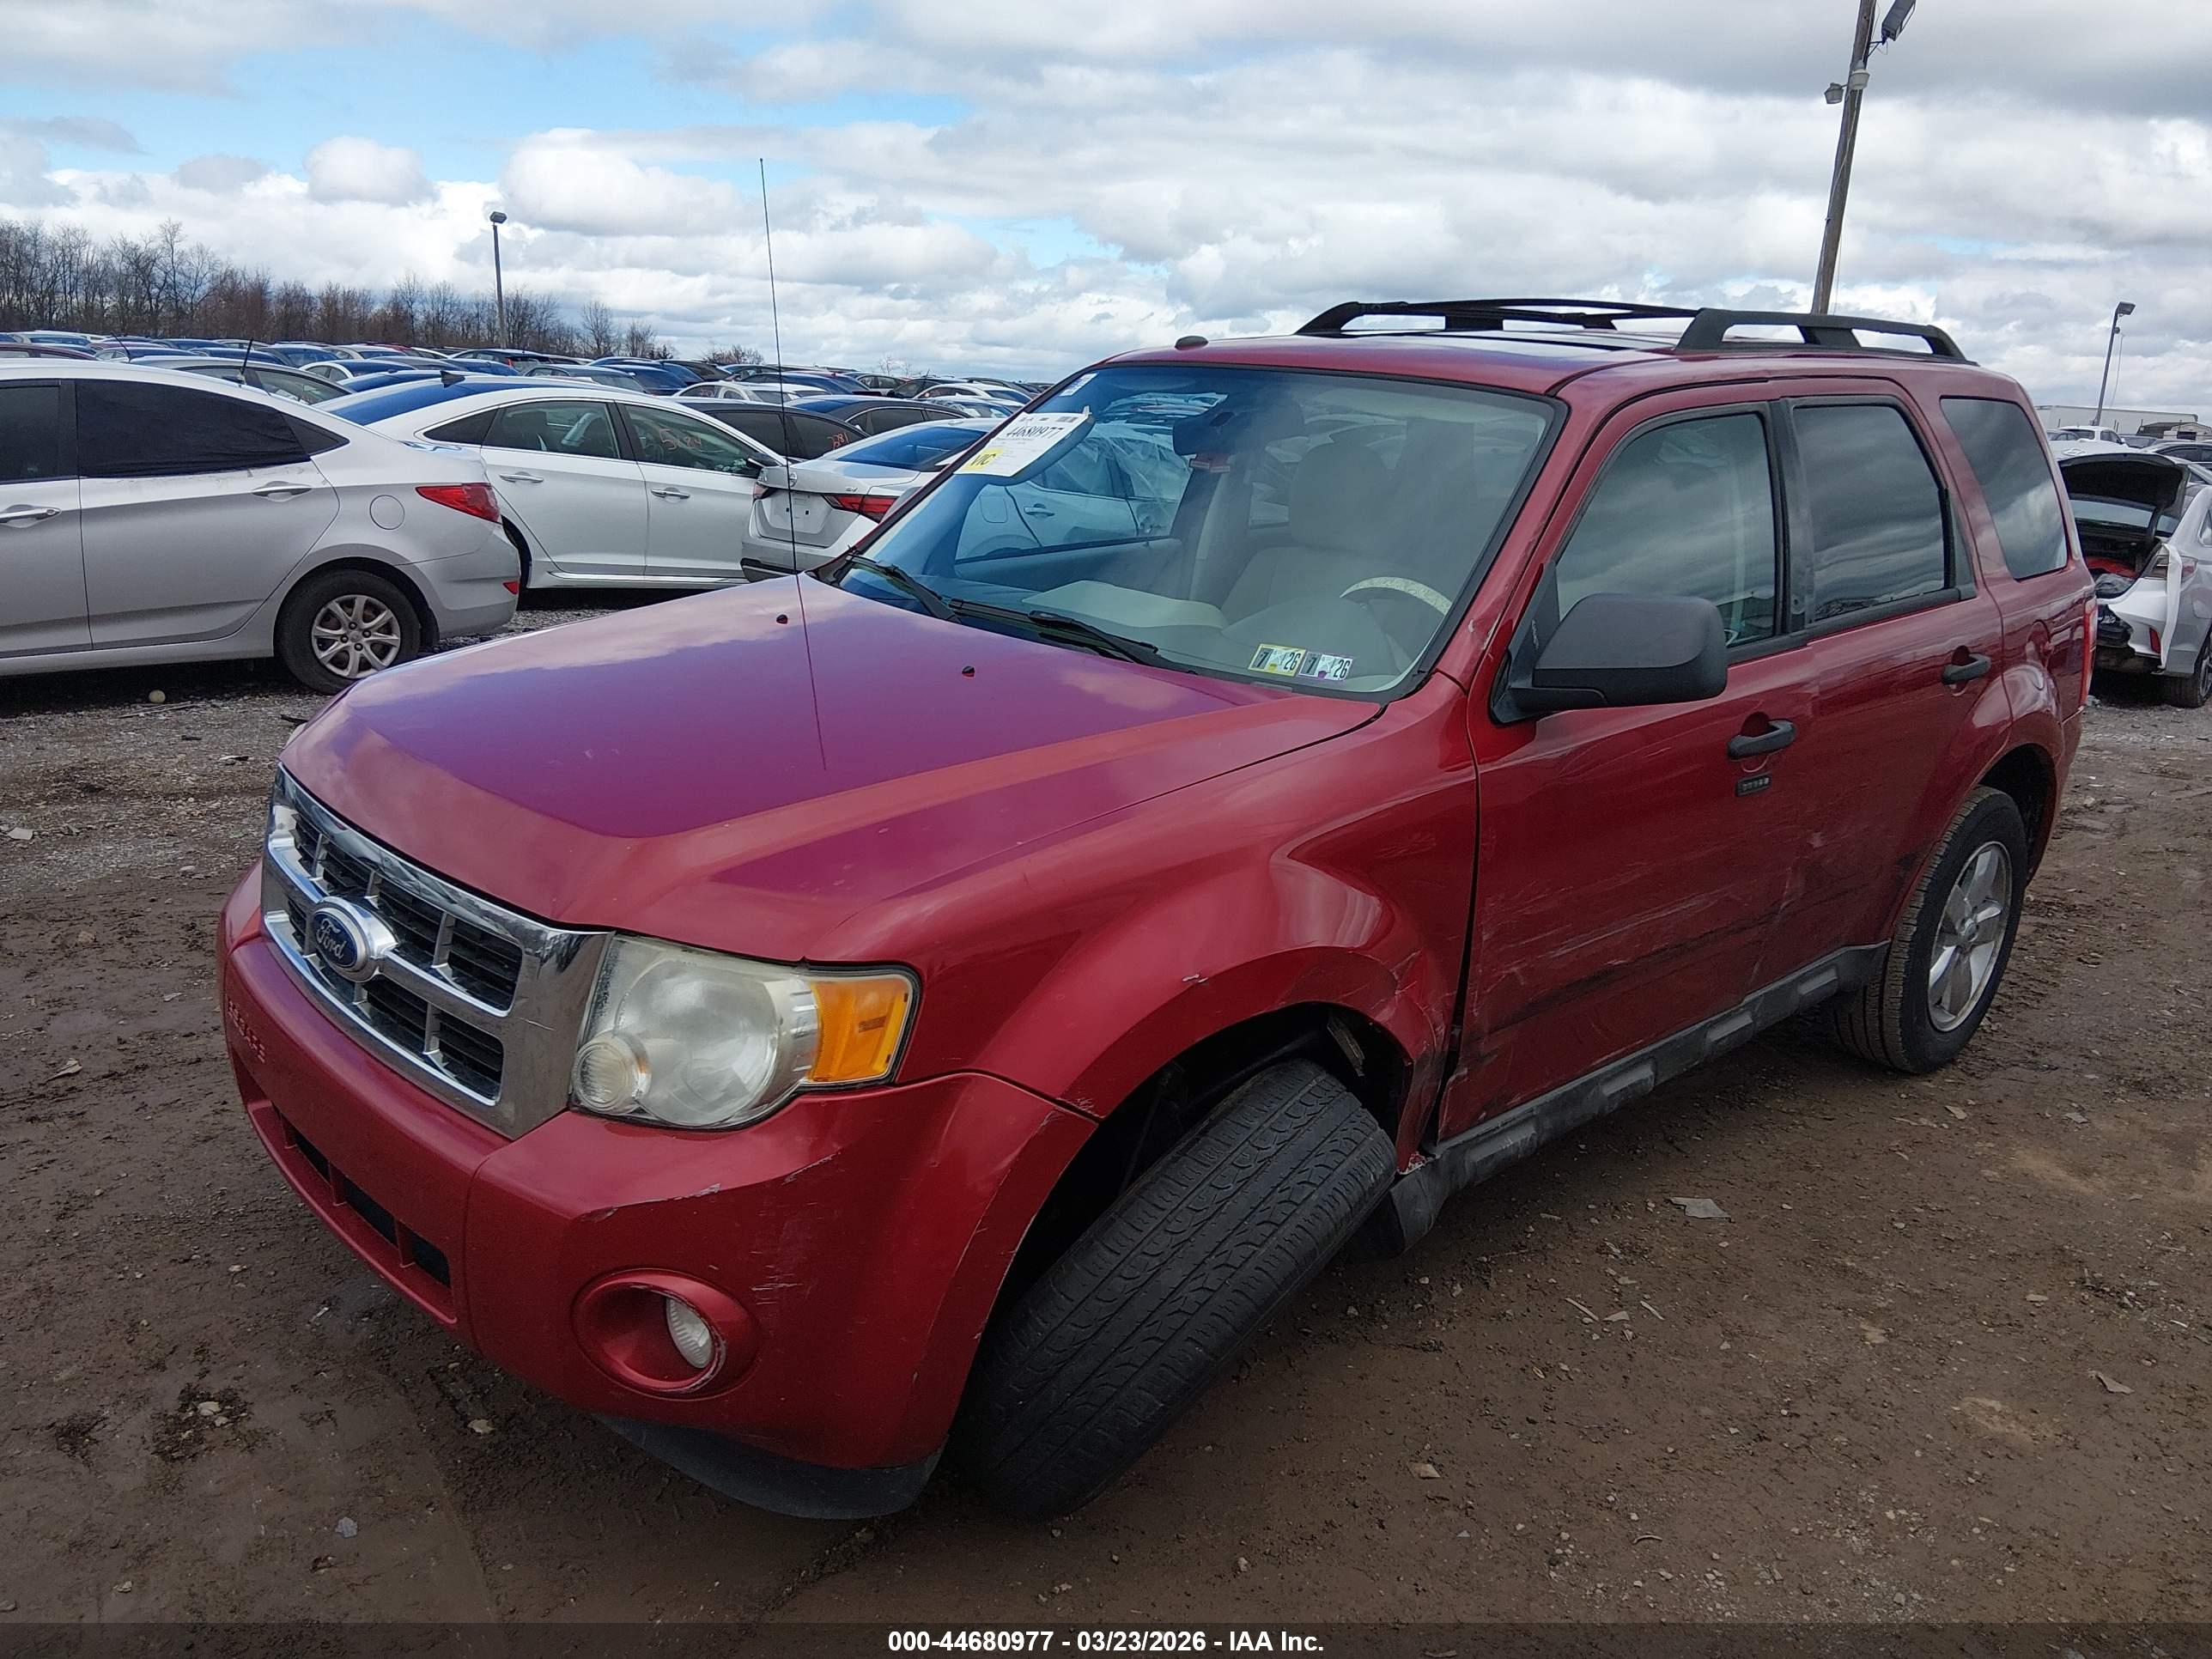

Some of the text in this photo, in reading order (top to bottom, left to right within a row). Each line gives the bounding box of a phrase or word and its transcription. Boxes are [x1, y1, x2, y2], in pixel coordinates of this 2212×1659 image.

[1006, 425, 1065, 439] 44680977
[969, 453, 997, 466] VIC
[1256, 652, 1302, 671] 7 26
[1306, 657, 1351, 678] 7 26
[315, 918, 347, 959] Ford
